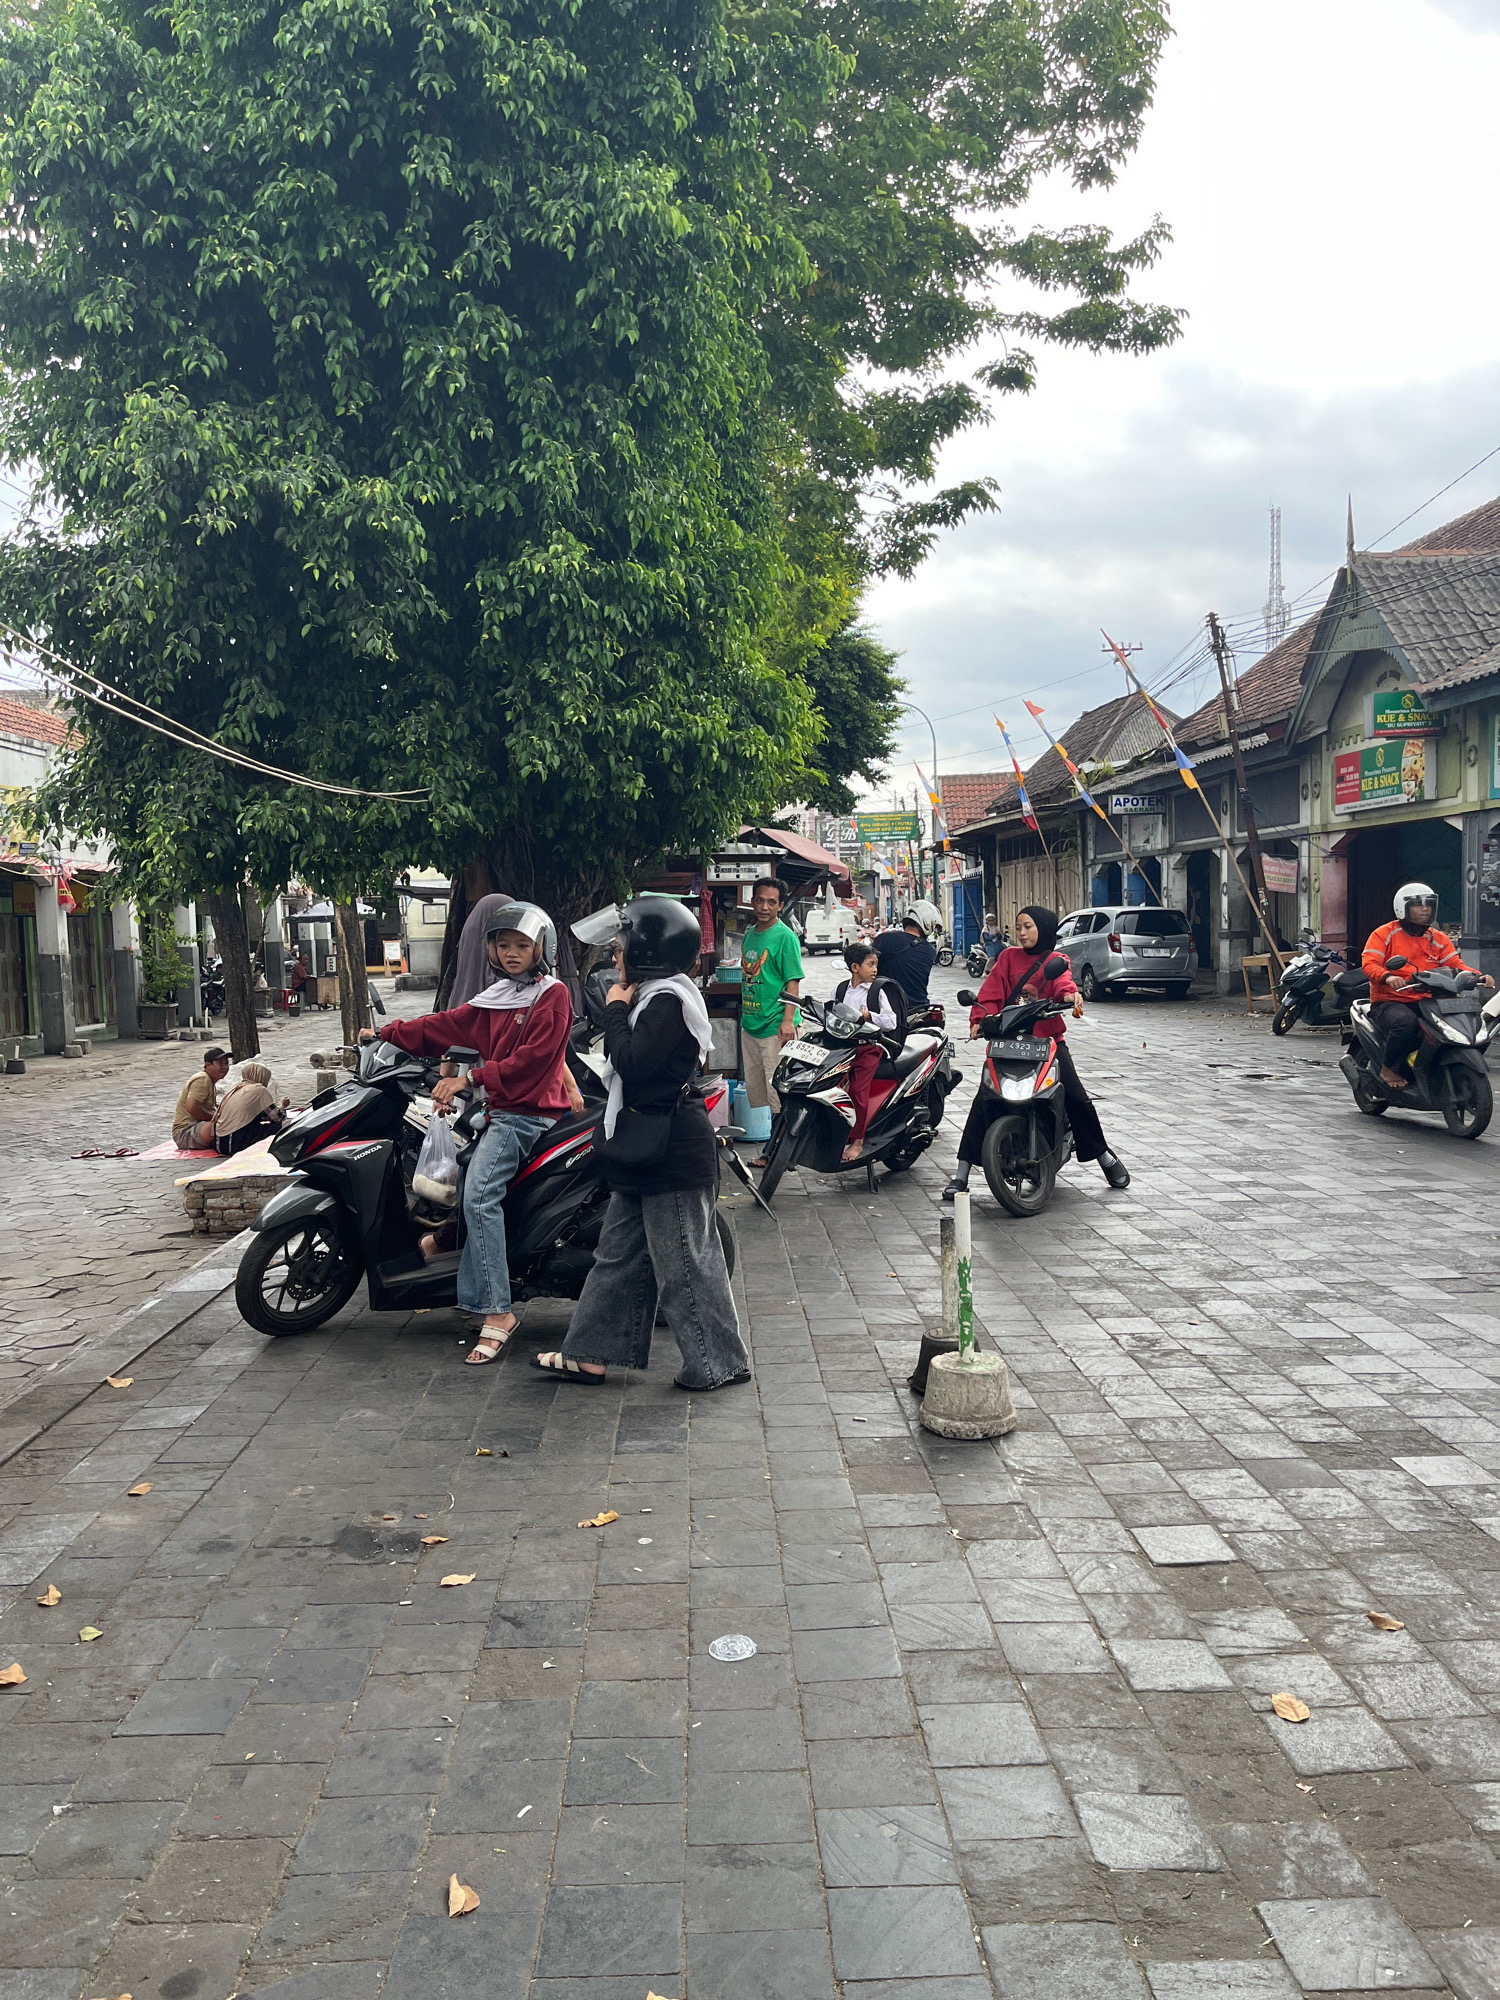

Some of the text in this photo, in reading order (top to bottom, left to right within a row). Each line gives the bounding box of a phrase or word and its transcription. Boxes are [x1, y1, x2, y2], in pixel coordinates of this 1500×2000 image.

[1377, 712, 1440, 723] KUE & SNACK
[1362, 778, 1373, 791] KUE
[1374, 777, 1378, 788] &
[1380, 772, 1399, 788] SNACK
[1114, 796, 1164, 807] APOTEK
[354, 1145, 383, 1161] HONDA
